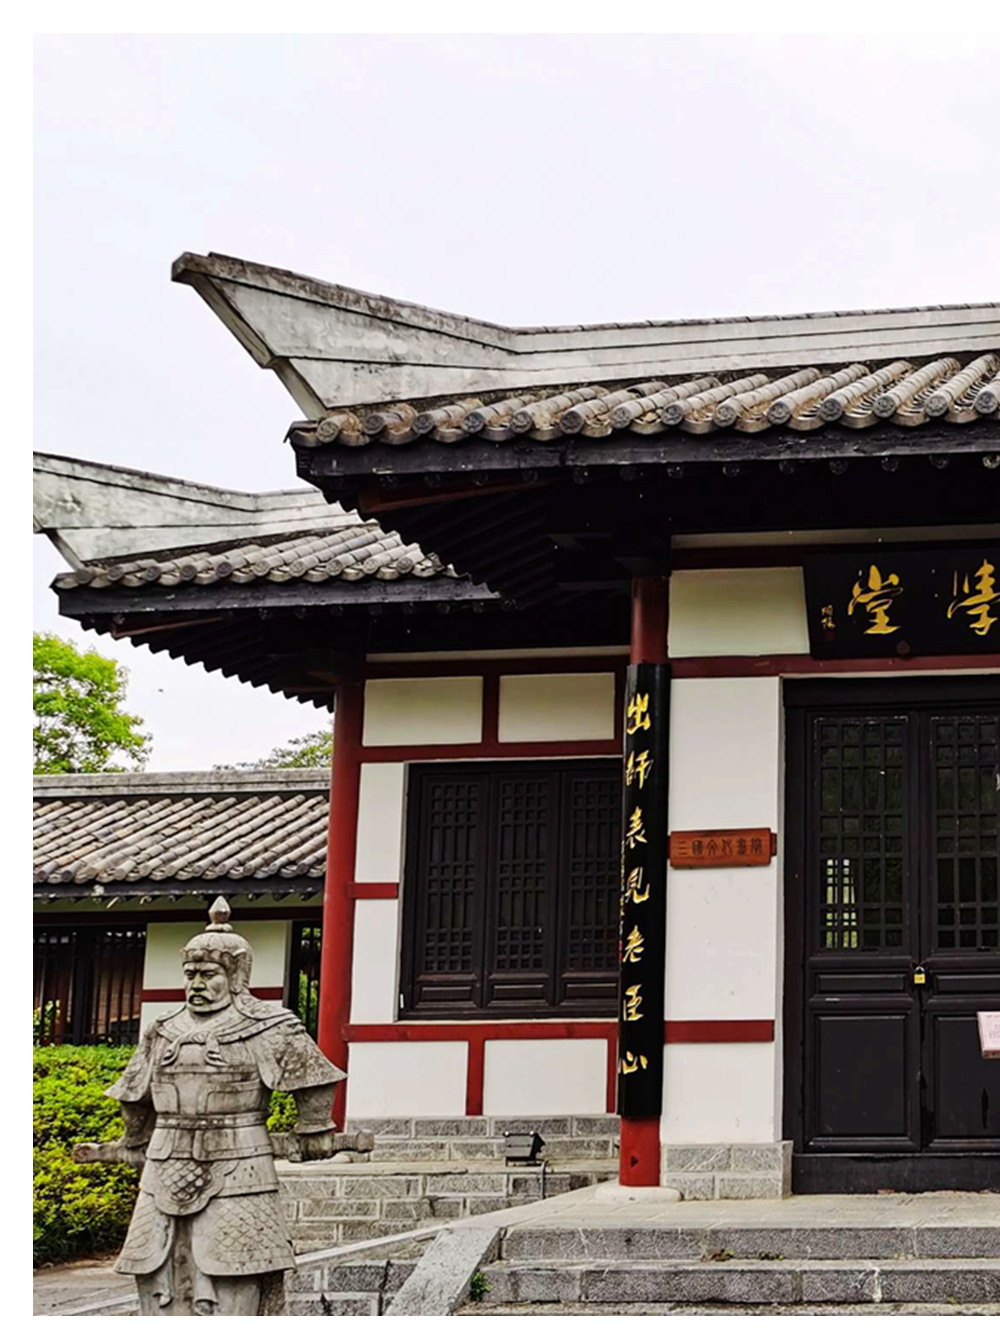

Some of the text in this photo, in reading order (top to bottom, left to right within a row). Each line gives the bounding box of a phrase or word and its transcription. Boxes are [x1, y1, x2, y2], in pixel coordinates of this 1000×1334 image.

[618, 693, 654, 1075] 出師表見老臣心
